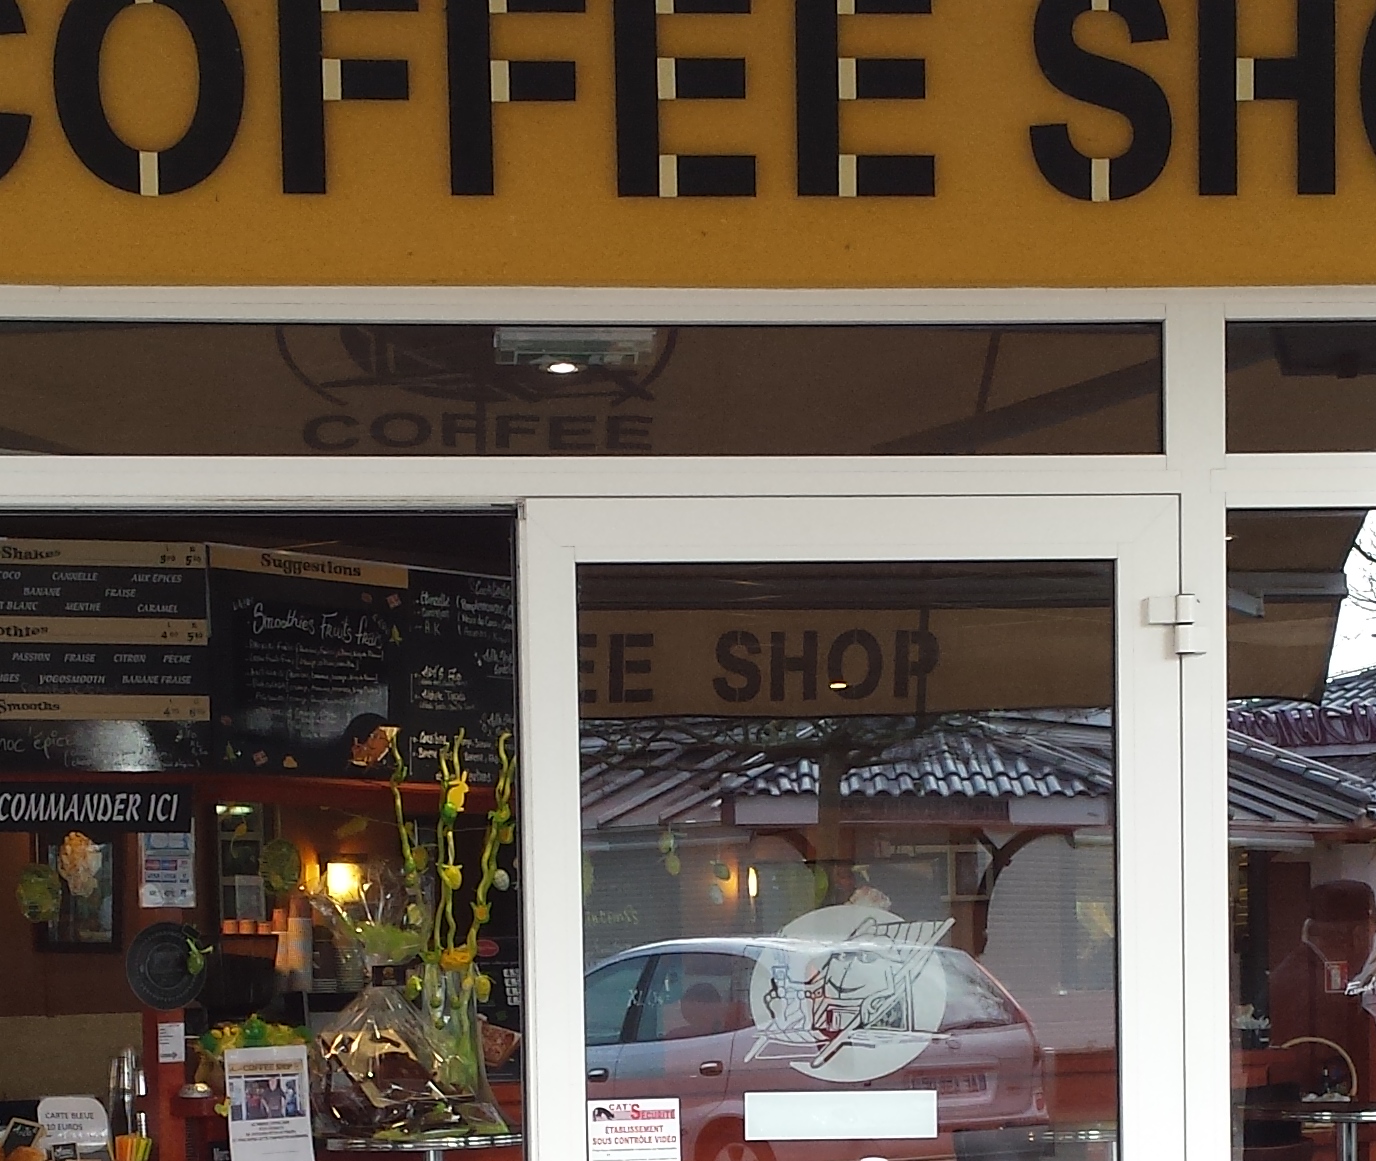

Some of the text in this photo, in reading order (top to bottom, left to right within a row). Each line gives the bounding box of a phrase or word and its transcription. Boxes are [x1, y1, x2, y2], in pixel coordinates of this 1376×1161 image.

[260, 553, 362, 578] Suggestions
[105, 588, 137, 599] FRAISE
[137, 603, 179, 614] CARAMEL
[12, 652, 51, 662] PASSION
[64, 653, 96, 663] FRAISE
[113, 653, 147, 664] CITRON
[712, 628, 940, 702] SHOP
[147, 793, 179, 823] ICI
[592, 1137, 612, 1145] SOUS
